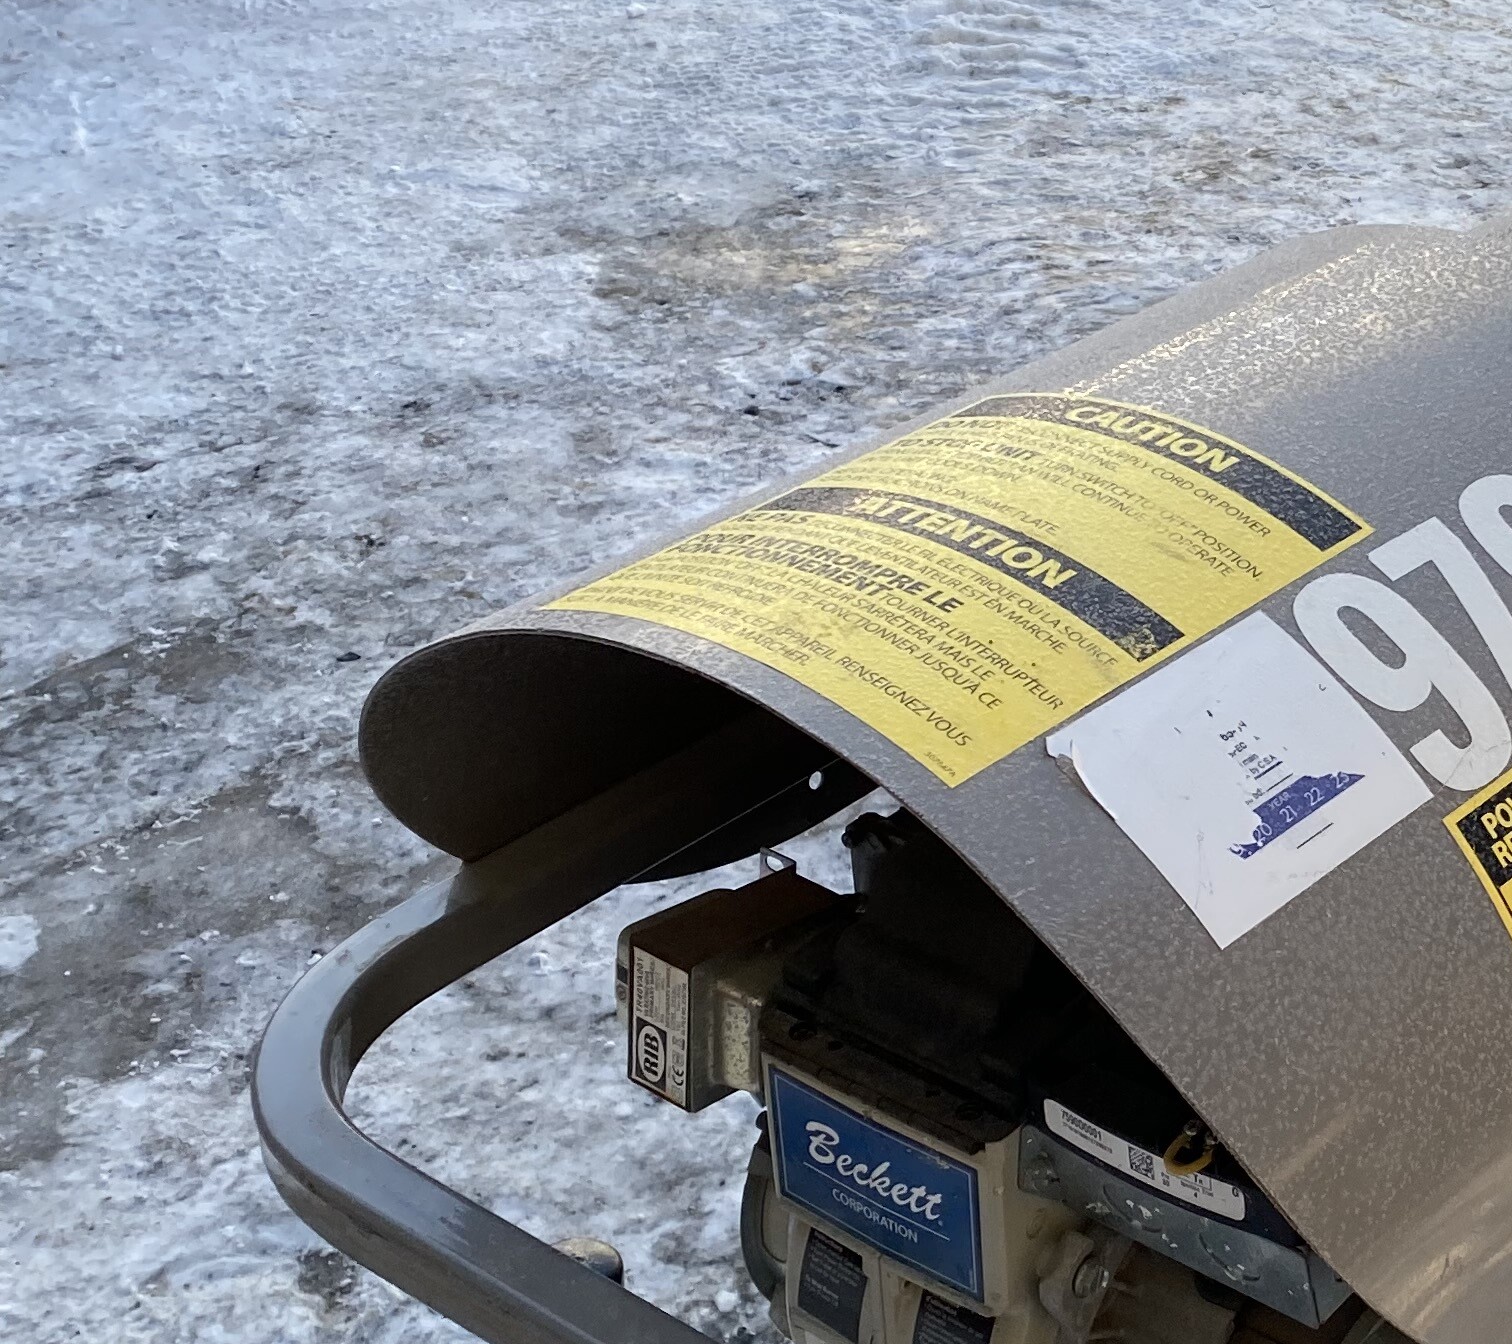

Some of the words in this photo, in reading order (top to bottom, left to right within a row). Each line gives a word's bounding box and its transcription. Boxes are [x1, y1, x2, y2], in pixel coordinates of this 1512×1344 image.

[1065, 406, 1241, 473] CAUTION
[849, 493, 1078, 590] ATTENTION
[1013, 509, 1061, 536] PLATE
[1072, 483, 1149, 522] CONTINUE
[1168, 532, 1236, 577] OPERATE
[1078, 471, 1137, 500] SWITCH
[1192, 529, 1263, 582] POSITION.
[1152, 467, 1194, 490] CORD
[1193, 489, 1218, 505] OR
[1216, 501, 1271, 537] POWER
[751, 535, 931, 596] INTERROMPRE
[922, 589, 965, 614] LE
[936, 555, 1021, 603] ÉLECTRIQUE
[1040, 612, 1061, 630] LA
[1058, 625, 1119, 667] SOURCE
[668, 543, 894, 596] FONCTIONNEMENT
[879, 592, 949, 632] TOURNER
[946, 628, 1064, 710] L'INTERRUPTEUR
[787, 570, 856, 603] CHALEUR
[935, 640, 972, 669] MAIS
[971, 662, 995, 682] LE
[813, 600, 920, 655] FONCTIONNER
[978, 692, 1003, 710] CE
[960, 585, 986, 602] EST
[1003, 611, 1067, 656] MARCHE
[773, 623, 837, 660] APPAREIL
[836, 655, 930, 716] RENSEIGNEZ
[927, 711, 972, 747] VOUS
[1257, 753, 1278, 770] CSA
[1268, 790, 1292, 809] YEAR
[1251, 822, 1274, 848] 20
[1278, 806, 1298, 824] 21
[1303, 786, 1325, 807] 22
[642, 1031, 660, 1077] RIB
[805, 1120, 944, 1222] Beckett
[831, 1187, 919, 1244] CORPORATION
